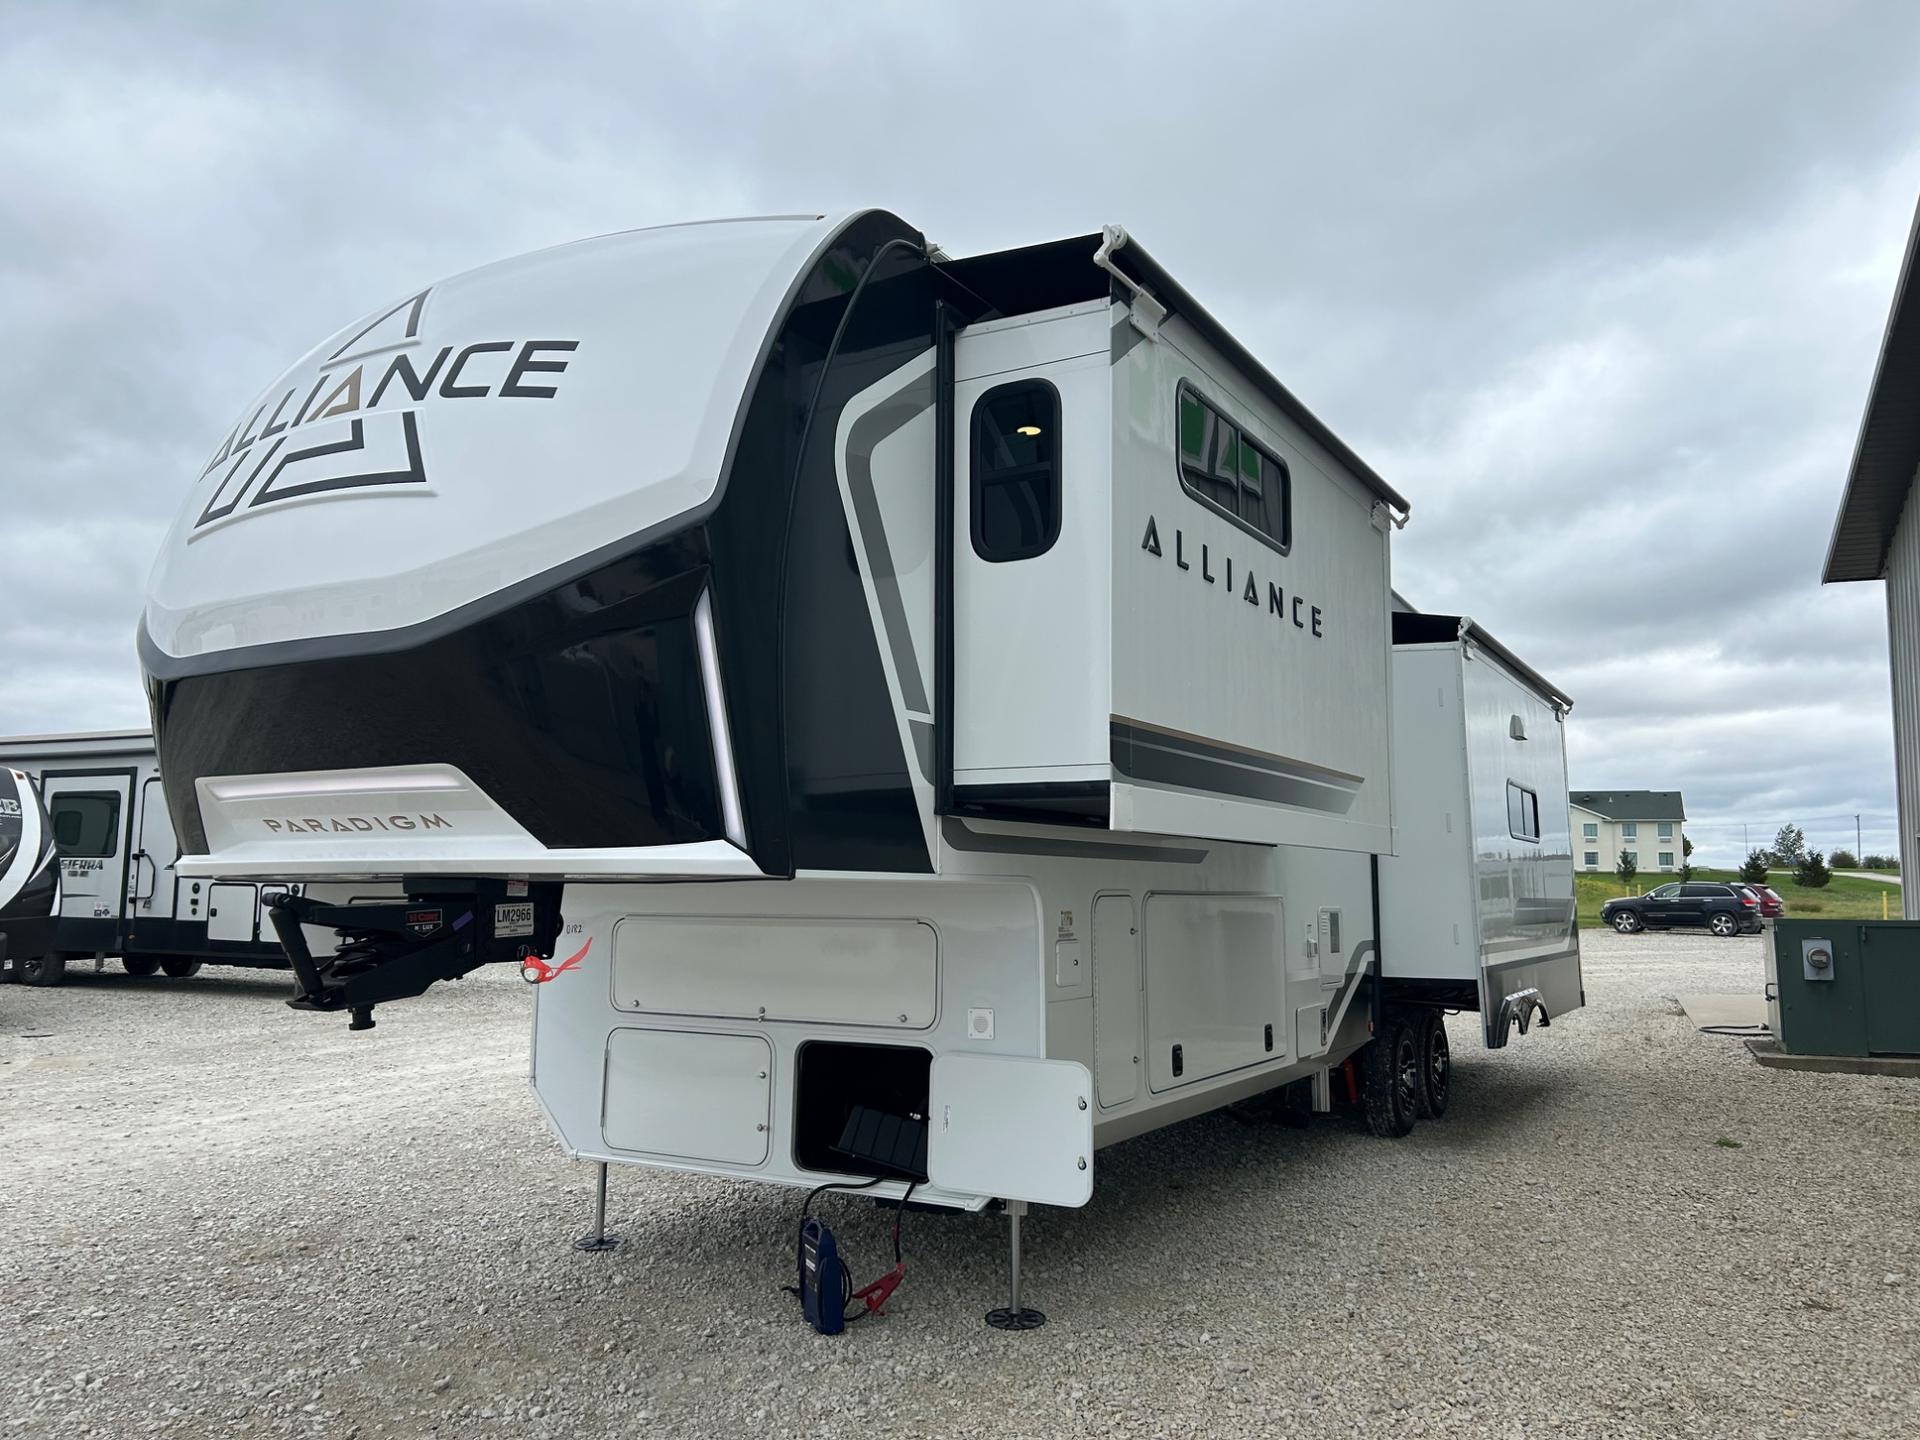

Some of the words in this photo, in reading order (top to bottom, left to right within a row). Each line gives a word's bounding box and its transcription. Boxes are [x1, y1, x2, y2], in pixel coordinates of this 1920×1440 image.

[198, 340, 581, 482] ALLIANCE
[1141, 514, 1322, 638] ALLIANCE
[262, 812, 454, 833] PARADIGM
[60, 859, 104, 870] SIERRA
[496, 908, 532, 923] LM2966
